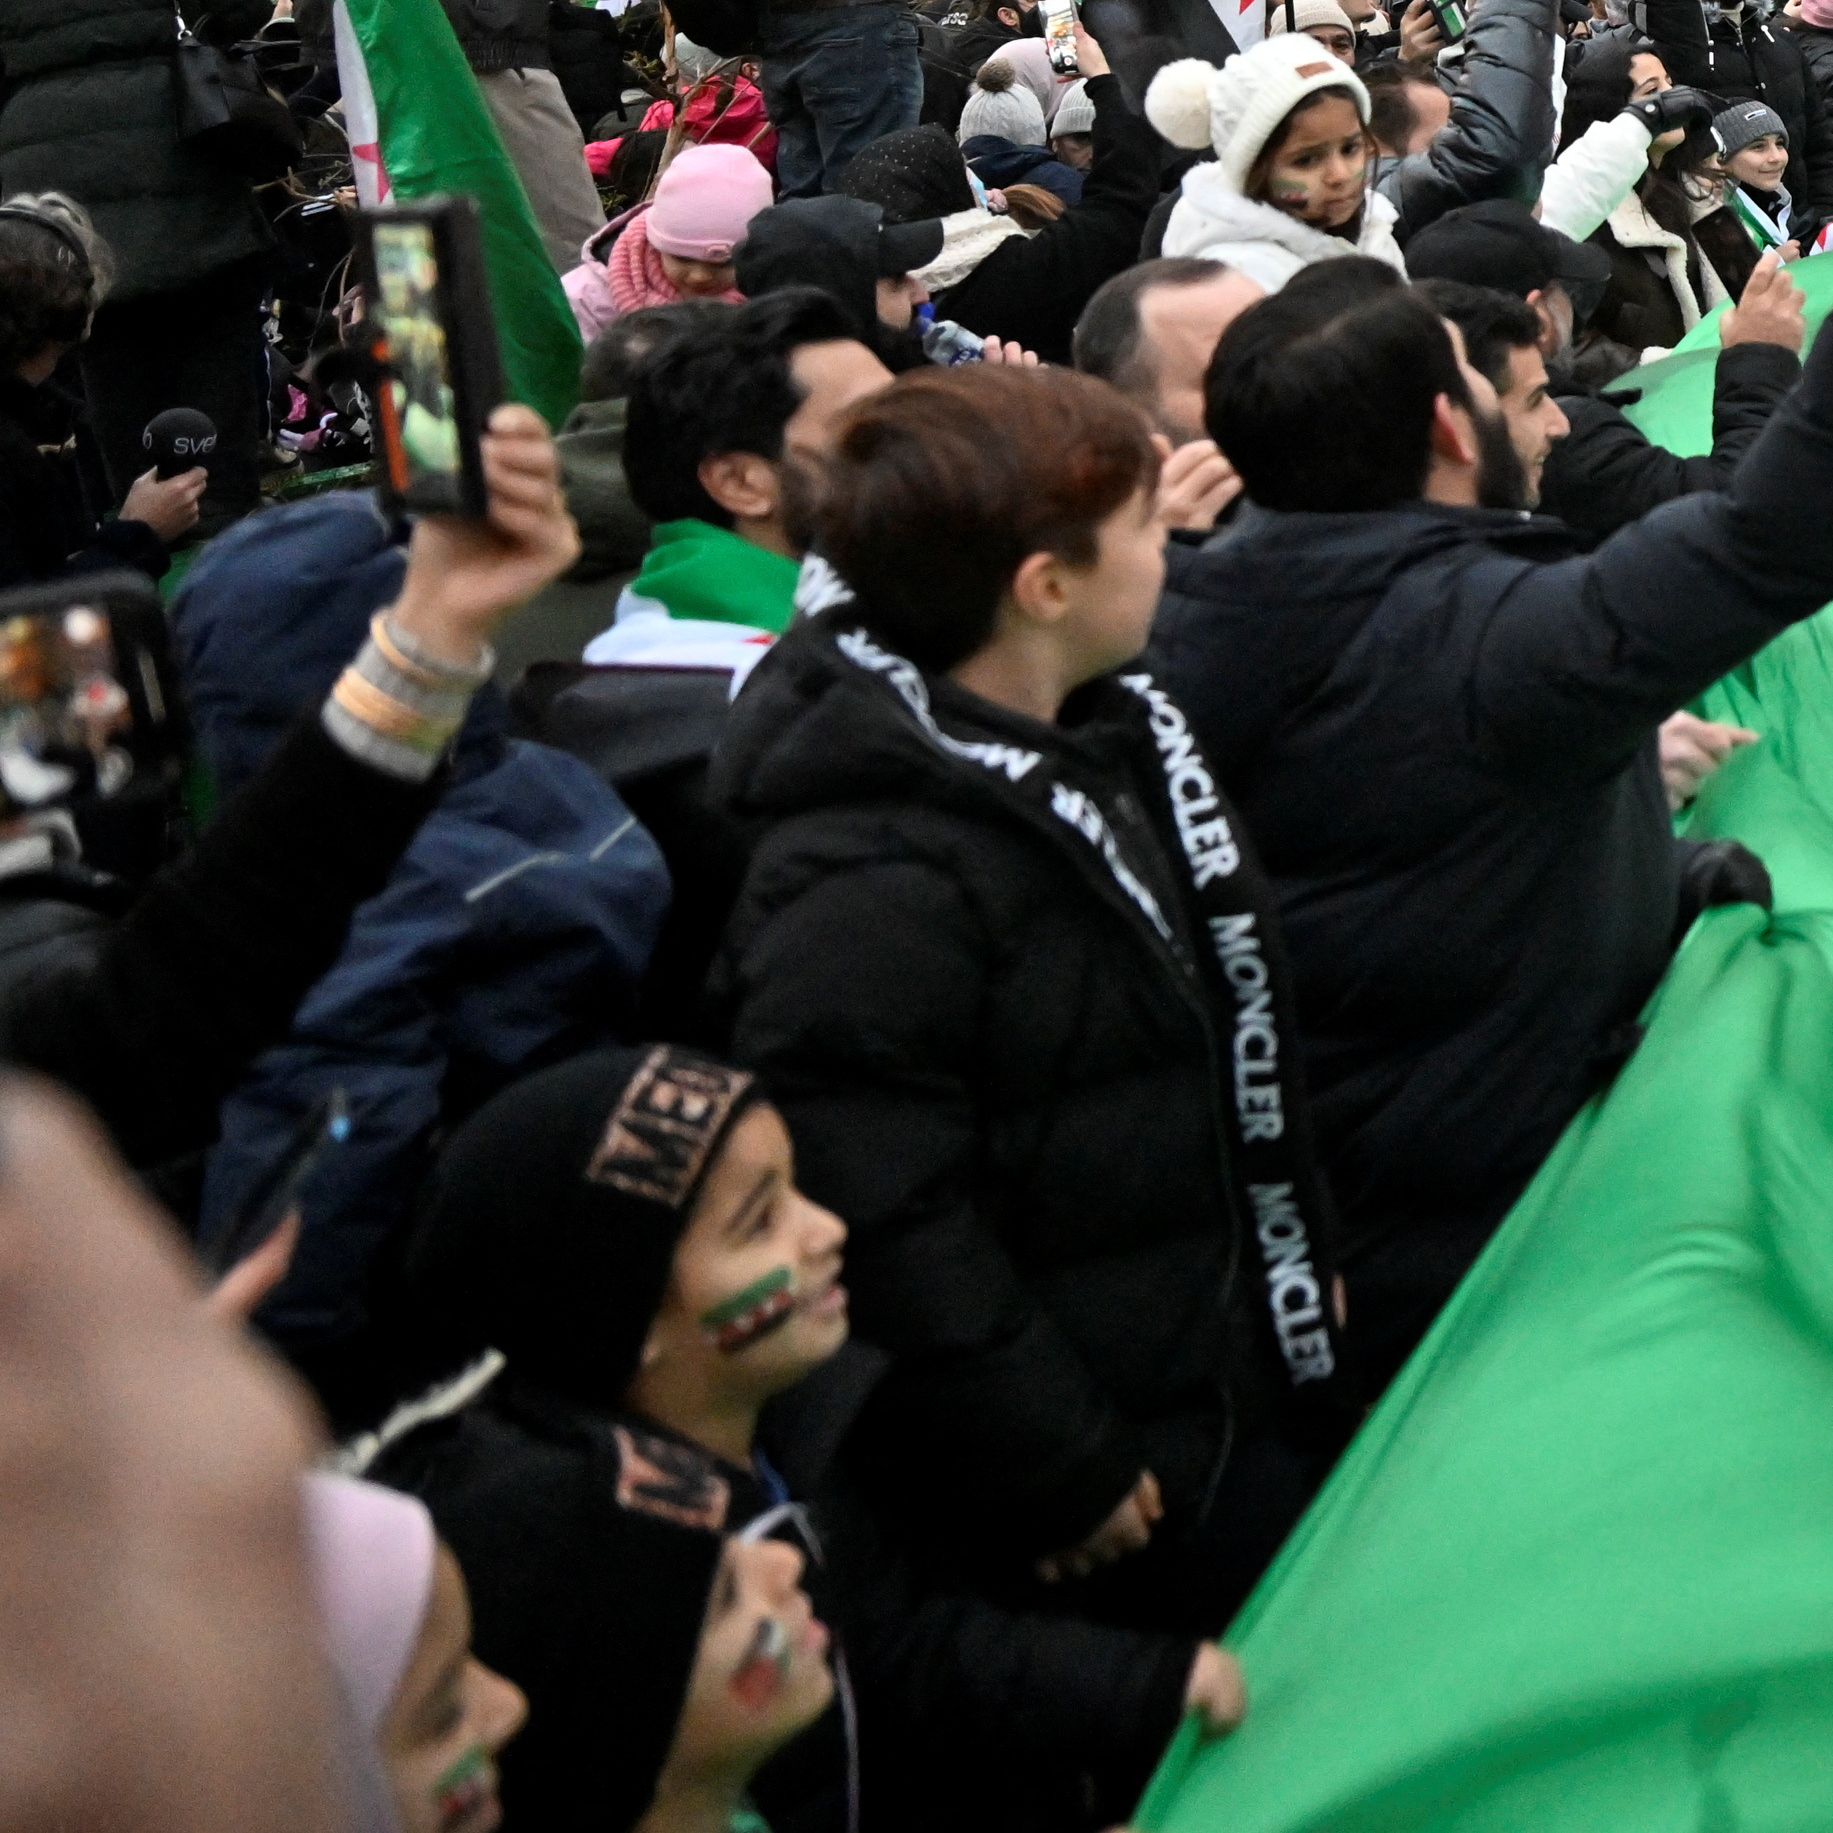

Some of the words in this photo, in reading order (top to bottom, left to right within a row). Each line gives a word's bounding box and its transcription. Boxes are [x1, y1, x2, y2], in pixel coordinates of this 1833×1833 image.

[1118, 672, 1241, 890] MONCLER
[1208, 912, 1287, 1144] MONCLER
[1250, 1182, 1338, 1387] MONCLER
